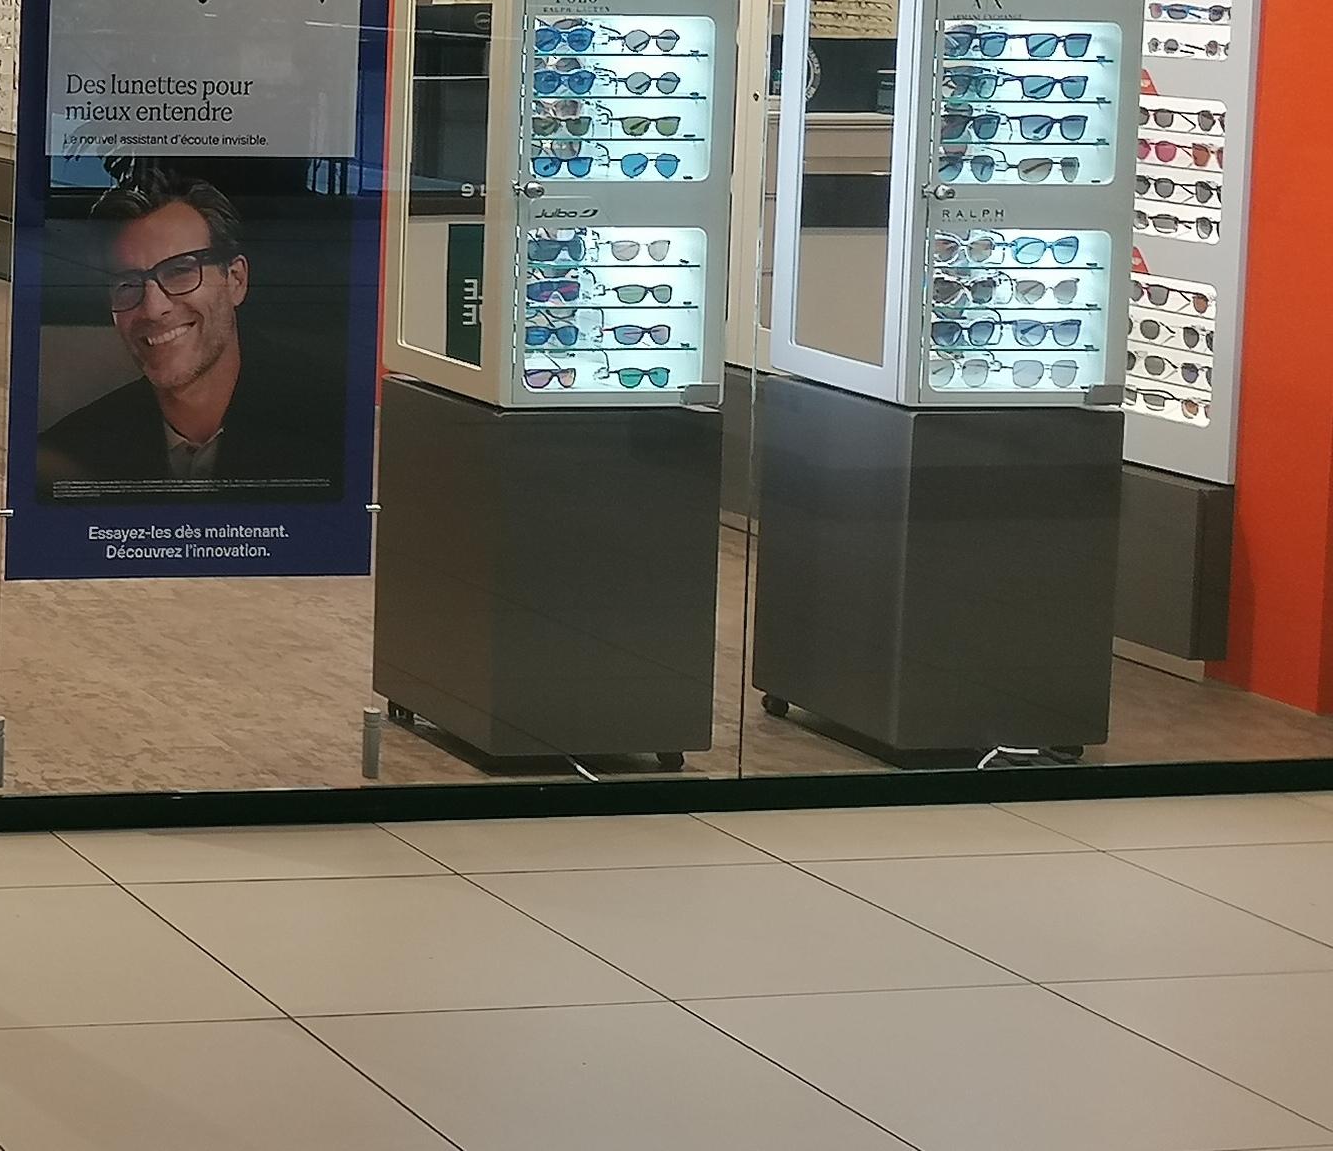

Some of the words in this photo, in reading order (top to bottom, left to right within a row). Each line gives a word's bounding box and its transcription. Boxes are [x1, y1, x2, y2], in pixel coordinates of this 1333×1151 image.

[66, 74, 106, 94] Des
[110, 73, 197, 95] lunettes
[202, 79, 253, 100] pour
[65, 101, 131, 121] mieux
[135, 100, 233, 121] entendre
[79, 133, 117, 145] nouvel
[120, 134, 168, 145] assistant
[171, 133, 219, 145] d'écoute
[222, 133, 269, 146] invisible.
[535, 208, 577, 219] Julbo
[942, 209, 1004, 218] RALPH
[88, 525, 172, 543] Essayez-les
[175, 524, 202, 539] dès
[204, 524, 289, 539] maintenant.
[106, 544, 183, 559] Découvrez
[185, 543, 271, 559] l'innovation.
